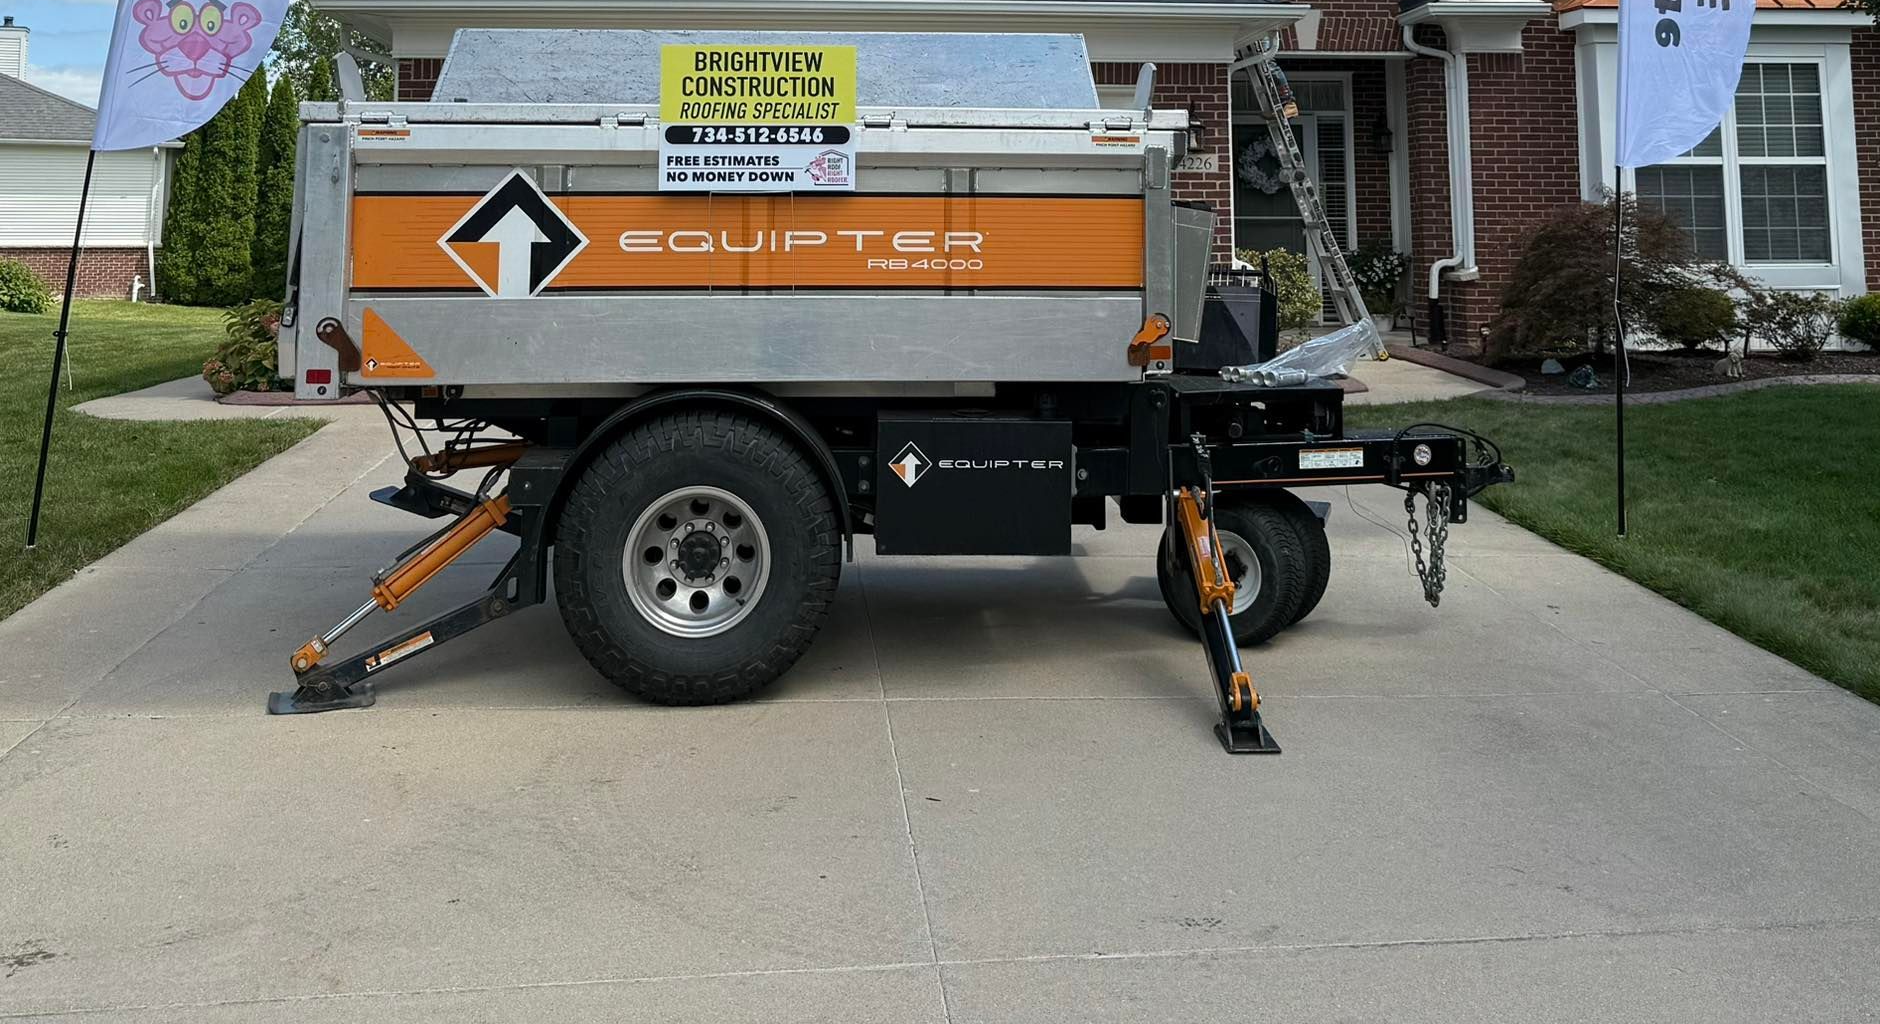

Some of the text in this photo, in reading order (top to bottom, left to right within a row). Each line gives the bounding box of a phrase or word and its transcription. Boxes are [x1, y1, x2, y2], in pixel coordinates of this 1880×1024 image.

[694, 51, 823, 73] BRIGHTVIEW
[681, 76, 835, 98] CONSTRUCTION
[680, 102, 840, 120] ROOFING SPECIALIST
[692, 127, 824, 143] 734-512-6546
[666, 155, 780, 167] FREE ESTIMATES
[1179, 156, 1212, 170] 4226
[666, 171, 795, 183] NO MONEY DOWN
[618, 230, 984, 253] EQUIPTER
[867, 259, 984, 270] RB4000
[938, 459, 1064, 469] EQUIPTER
